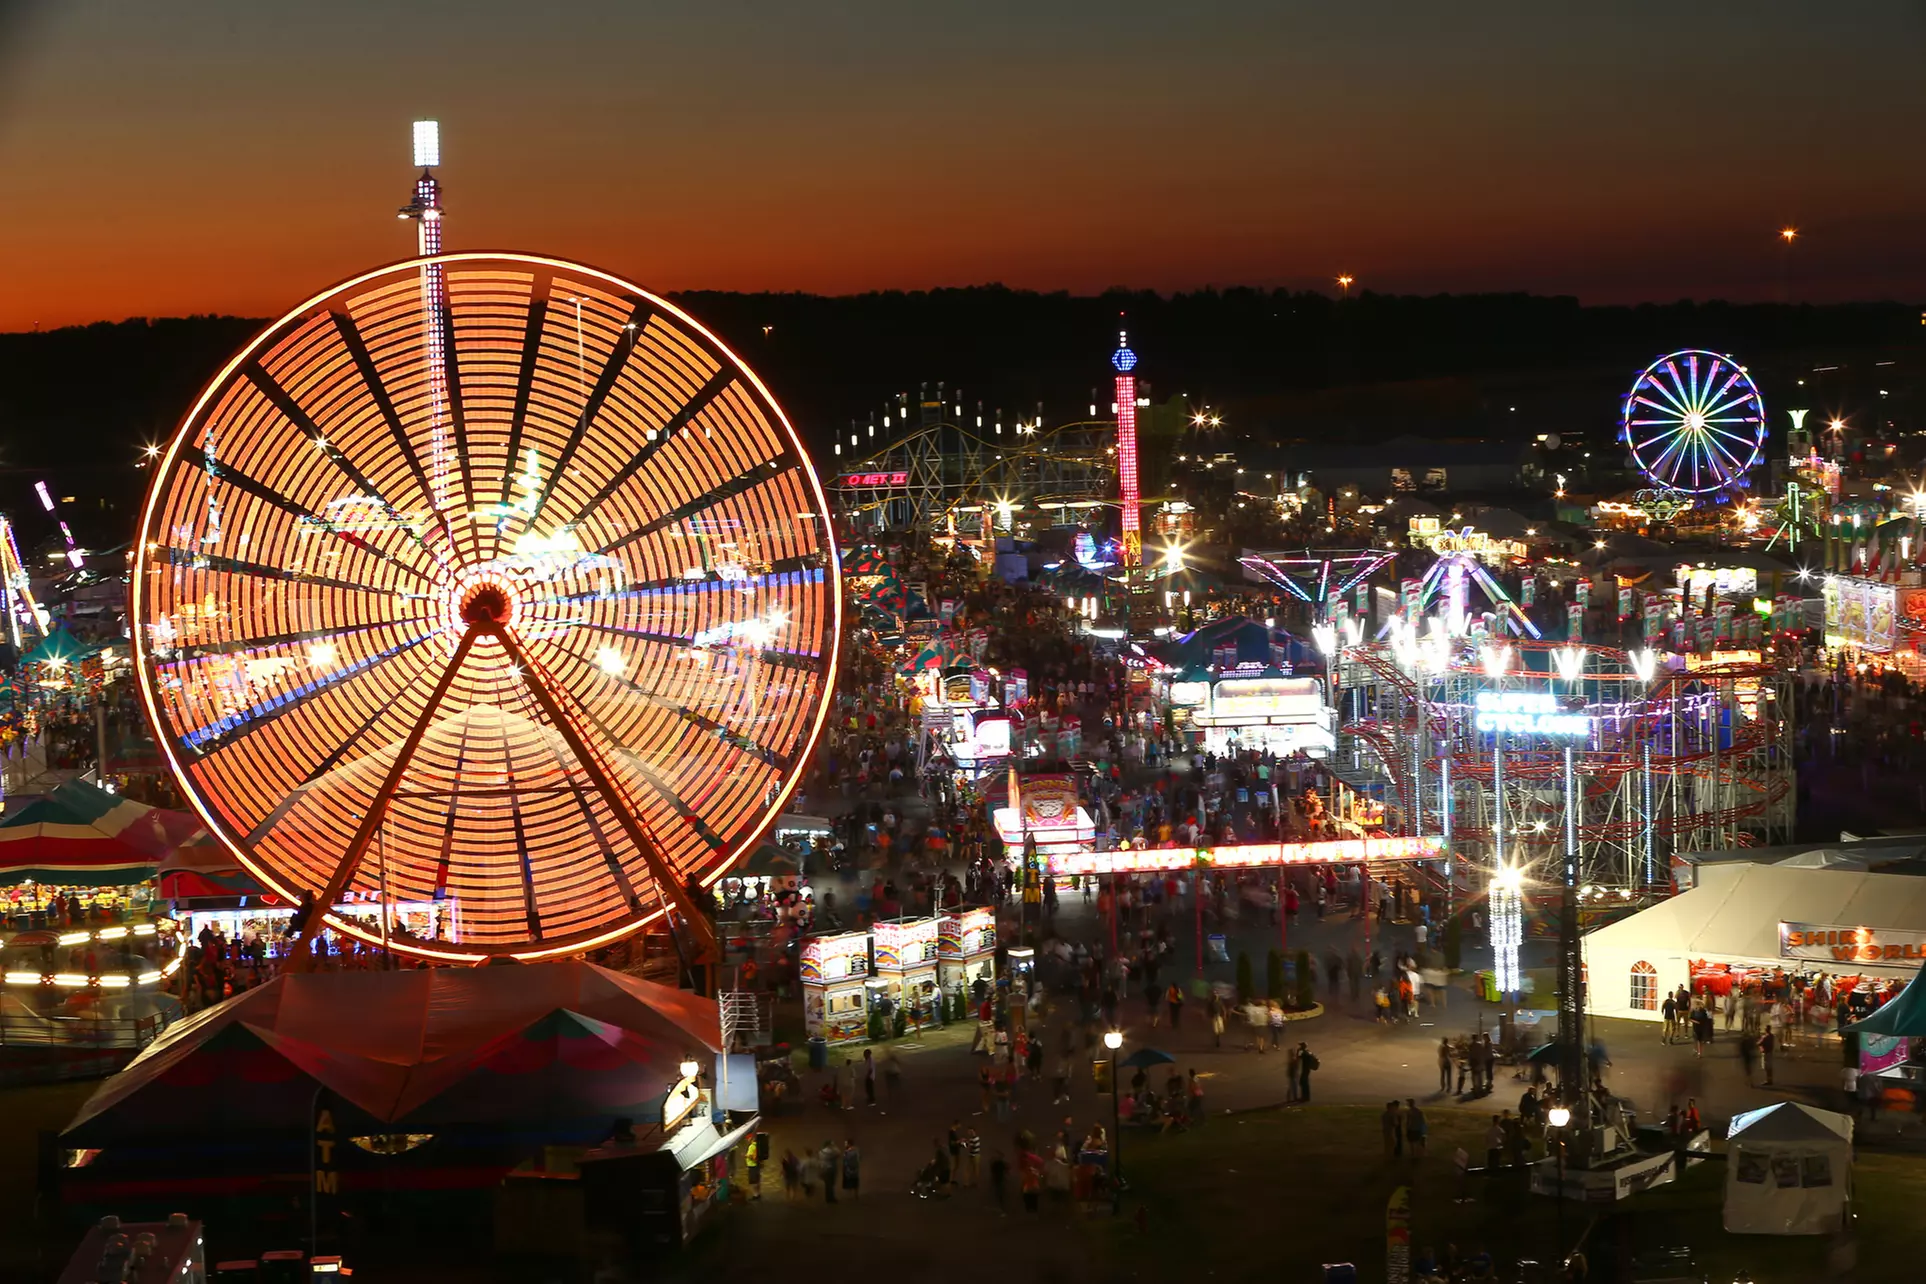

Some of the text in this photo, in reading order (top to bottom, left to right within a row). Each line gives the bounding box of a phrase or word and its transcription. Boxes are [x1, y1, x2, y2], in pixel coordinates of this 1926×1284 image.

[842, 473, 907, 485] OMET II
[1476, 692, 1556, 713] SUPER
[1476, 713, 1590, 735] CYCLONE
[1021, 780, 1073, 791] FUNNEL
[1024, 848, 1040, 903] ATM
[343, 890, 383, 902] air
[938, 922, 962, 936] ICKETS
[1788, 928, 1875, 946] SHIRT
[316, 1109, 337, 1195] ATM
